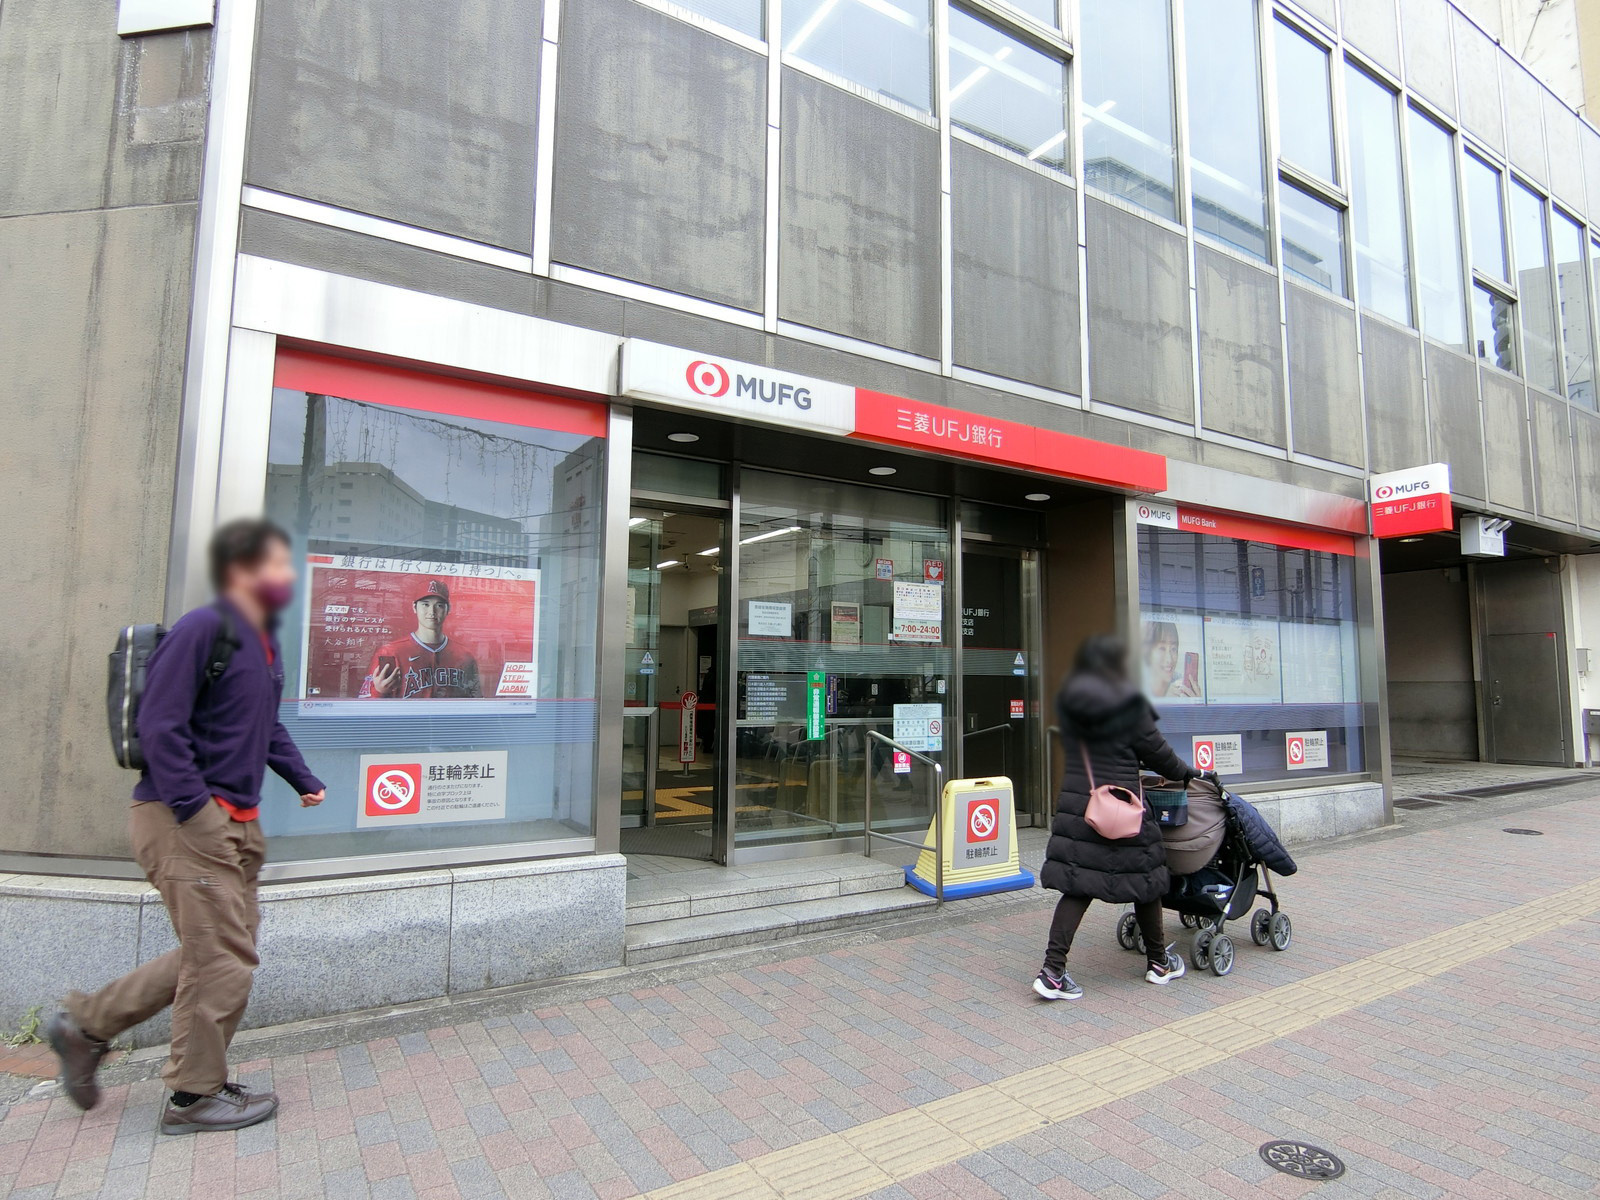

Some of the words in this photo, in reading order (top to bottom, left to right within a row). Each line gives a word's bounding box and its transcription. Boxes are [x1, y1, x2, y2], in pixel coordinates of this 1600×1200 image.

[736, 374, 812, 410] MUFG
[896, 408, 1003, 449] 三菱UFJ銀行
[1395, 481, 1430, 495] MUFG
[1375, 498, 1437, 517] 三菱UFJ銀行
[1151, 509, 1171, 521] MUFG
[1181, 515, 1201, 526] MUFG
[1201, 518, 1216, 529] Bank
[961, 607, 990, 617] UFJ銀行
[428, 763, 495, 781] 駐輪禁止
[965, 846, 998, 859] 駐輪禁止
